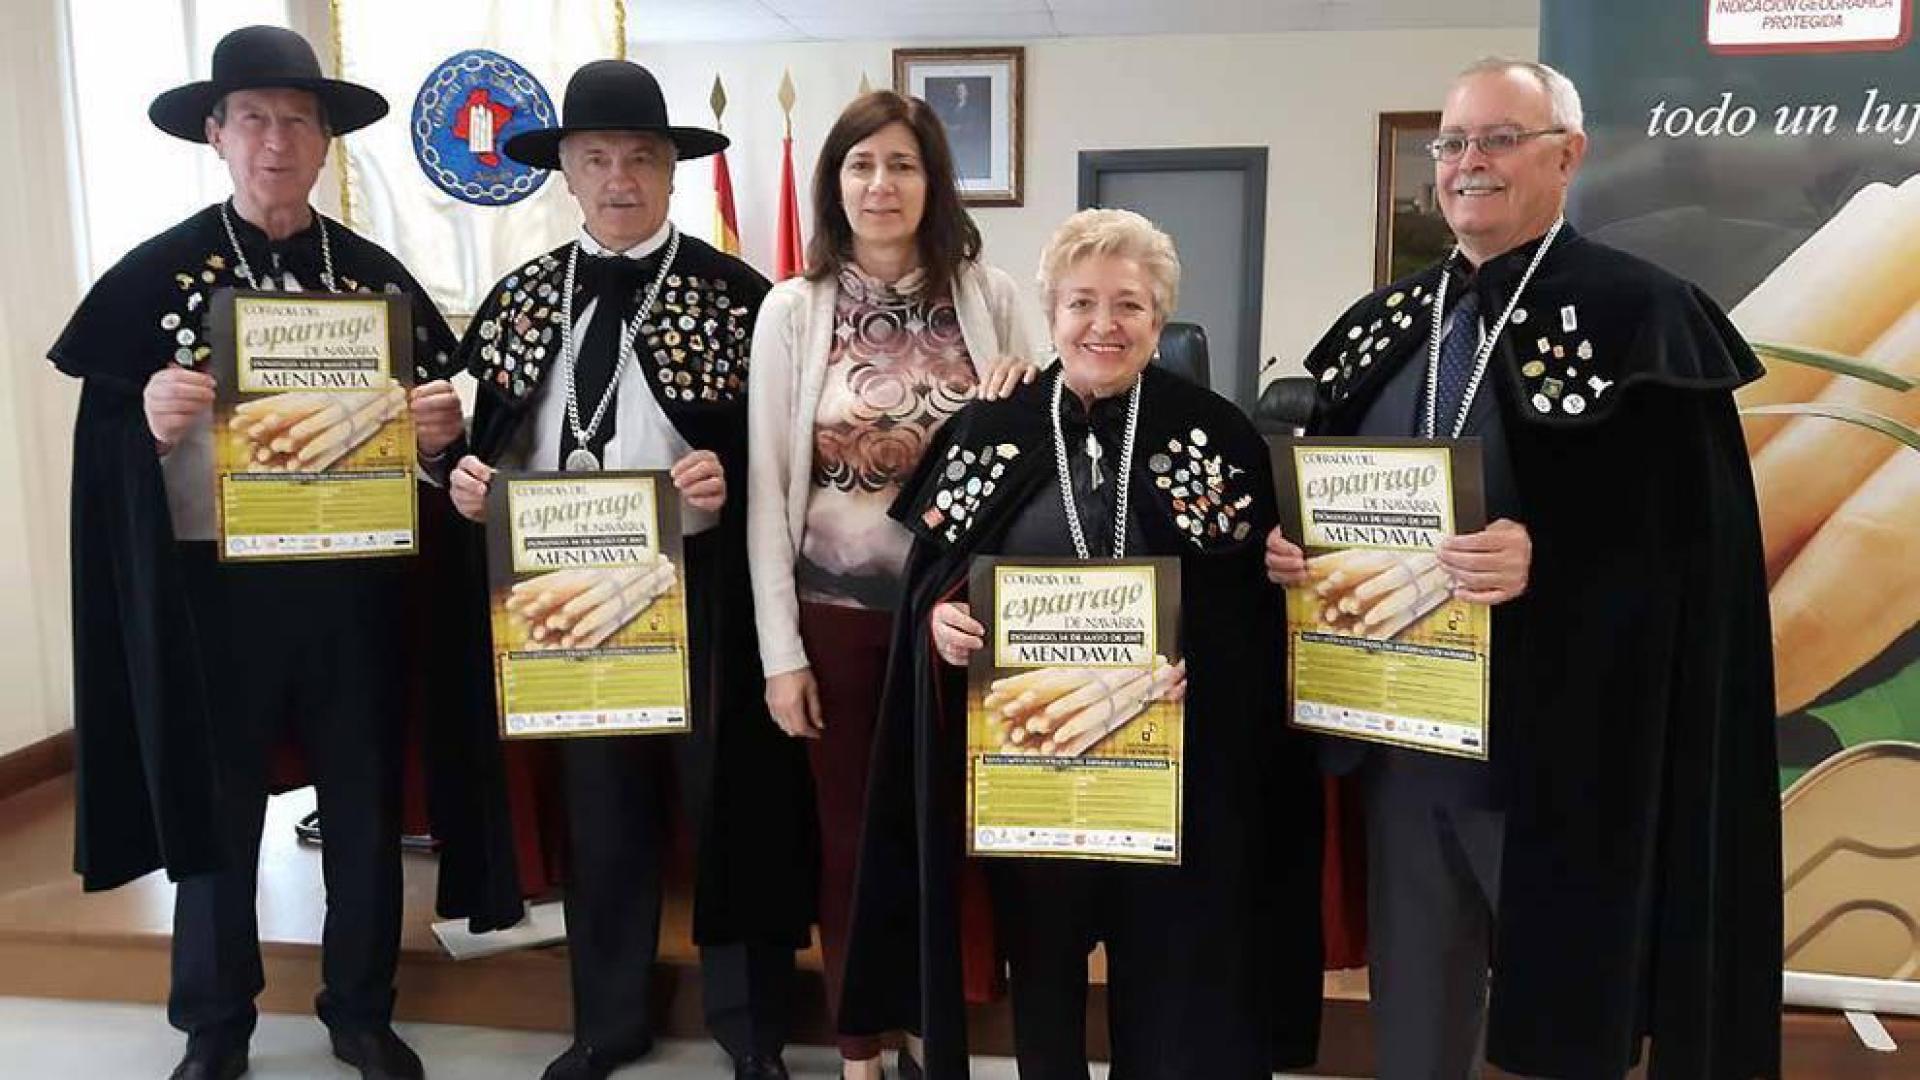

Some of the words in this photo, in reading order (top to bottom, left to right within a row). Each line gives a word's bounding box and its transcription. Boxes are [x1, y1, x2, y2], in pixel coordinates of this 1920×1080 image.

[1762, 14, 1843, 29] PROTEGIDA
[1647, 92, 1756, 137] todo
[1774, 103, 1840, 136] un
[246, 315, 376, 351] esparrago
[262, 371, 370, 387] MENDAVIA
[1306, 464, 1436, 502] esparrago
[518, 491, 643, 531] esparrago
[1382, 499, 1441, 513] NAVARRA
[1324, 526, 1434, 547] MENDAVIA
[535, 548, 639, 565] MENDAVIA
[1002, 583, 1143, 624] esparrago
[1064, 617, 1081, 629] DE
[1086, 617, 1145, 629] NAVARRA
[1019, 645, 1133, 662] MENDAVIA
